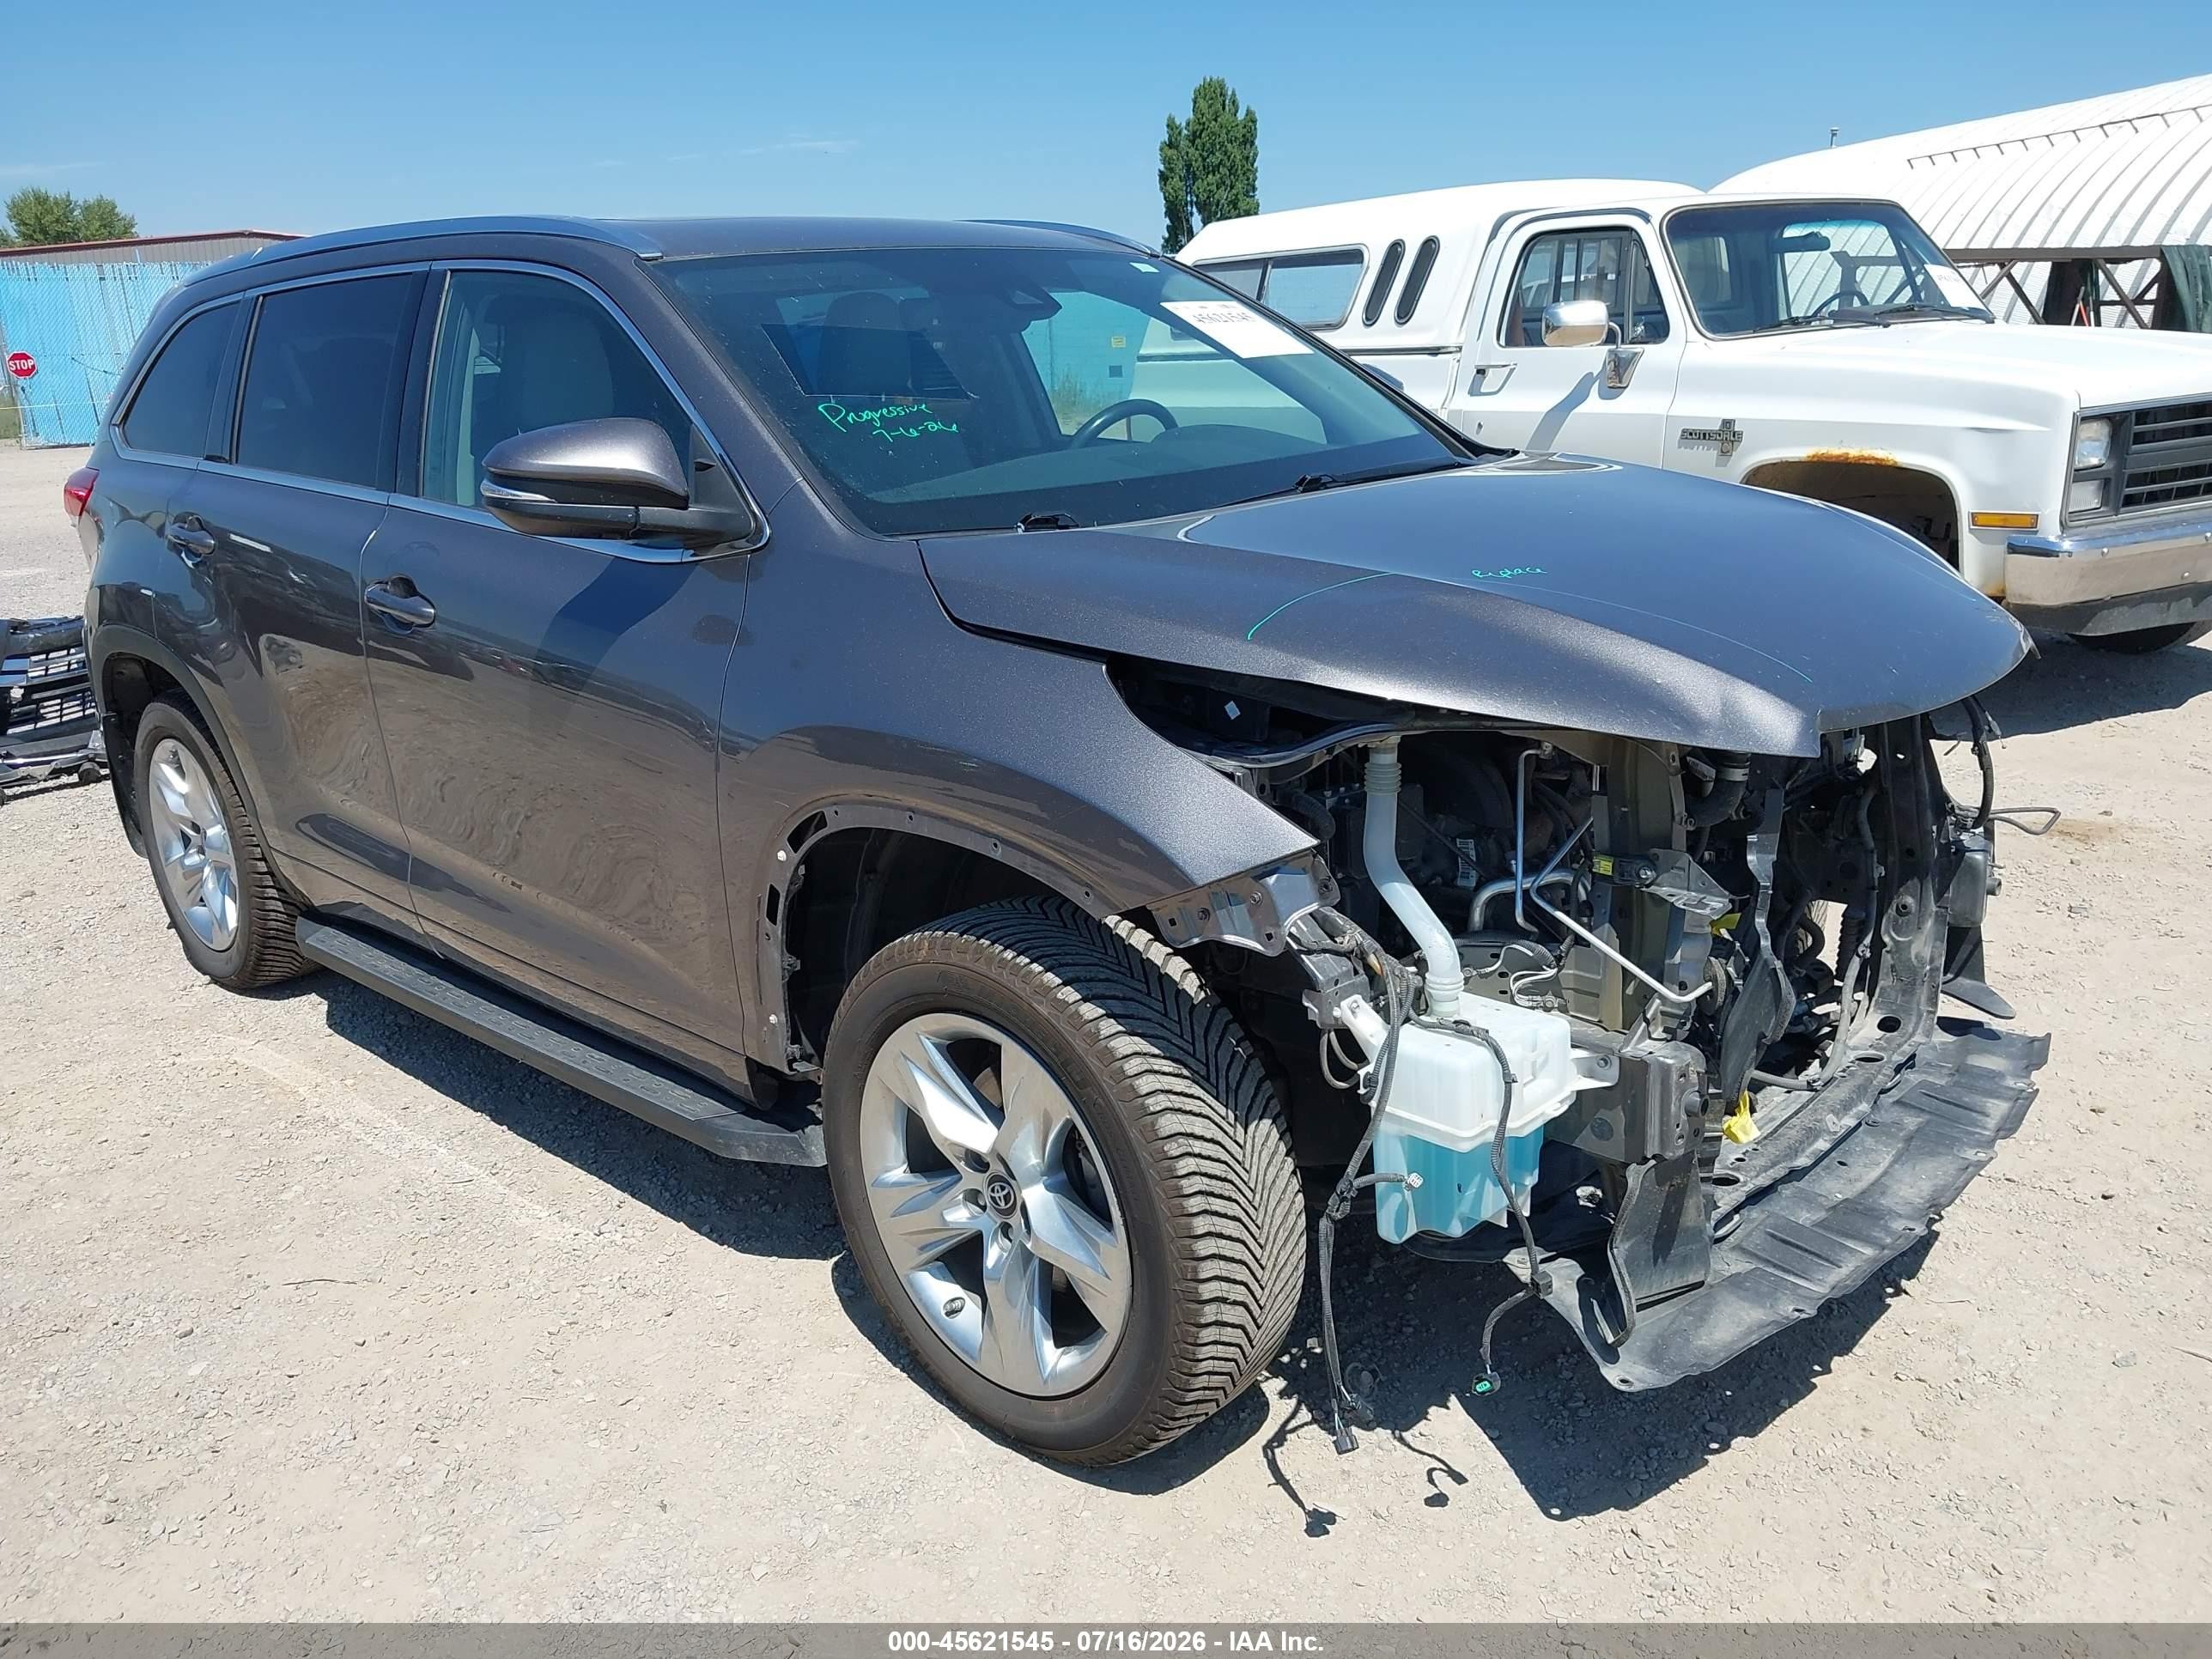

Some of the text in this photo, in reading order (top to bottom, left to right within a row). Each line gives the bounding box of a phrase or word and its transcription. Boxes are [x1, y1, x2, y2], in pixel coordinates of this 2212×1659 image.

[9, 359, 34, 370] STOP
[818, 404, 933, 432] Progressive
[1680, 429, 1742, 441] SCOTTSDALE
